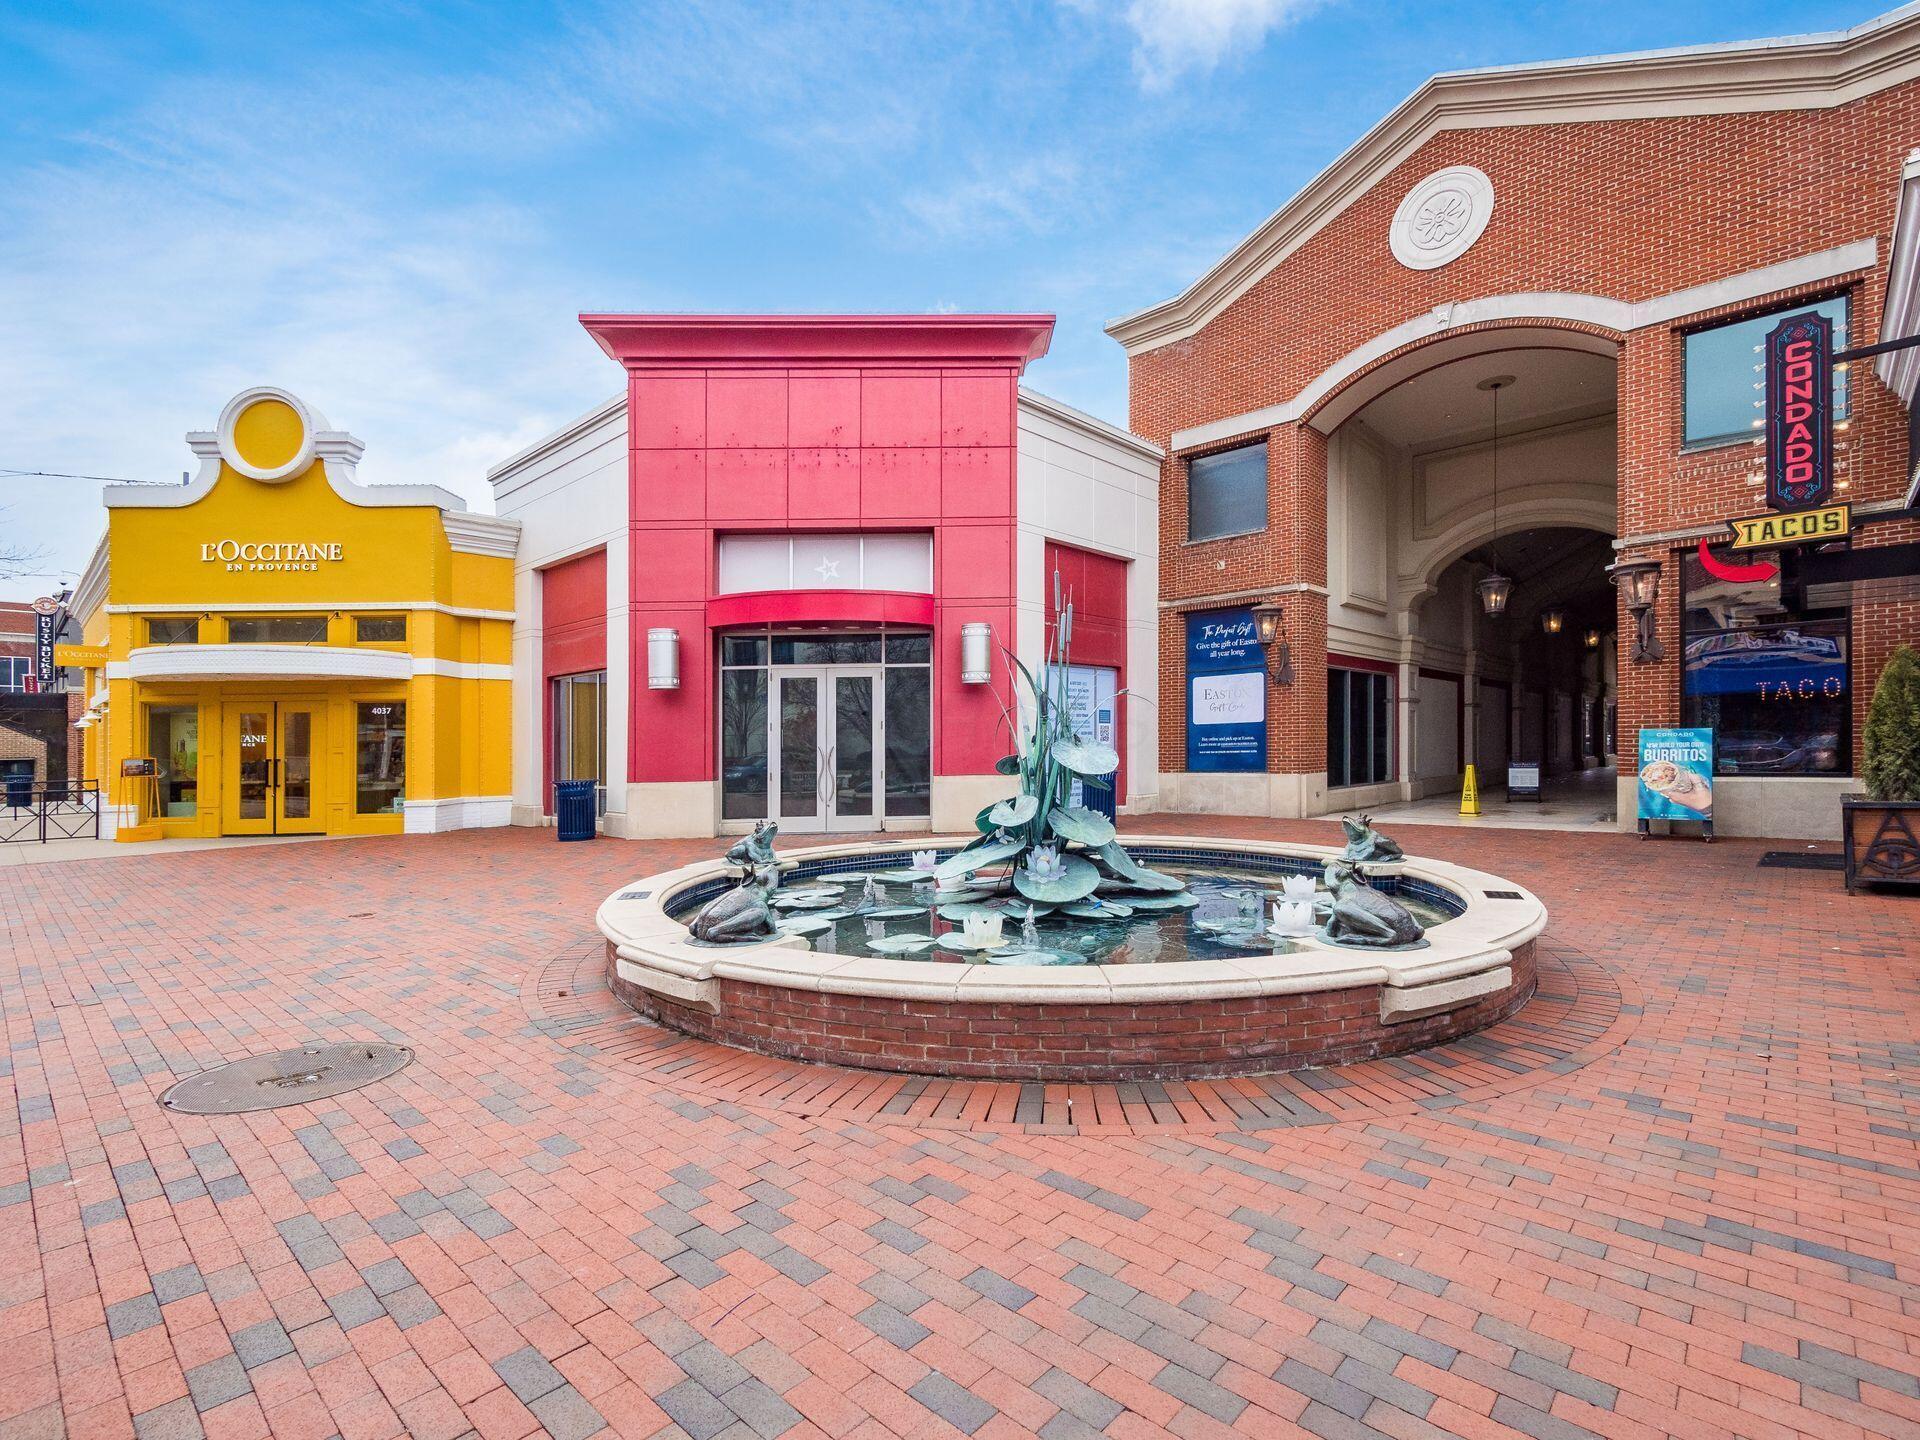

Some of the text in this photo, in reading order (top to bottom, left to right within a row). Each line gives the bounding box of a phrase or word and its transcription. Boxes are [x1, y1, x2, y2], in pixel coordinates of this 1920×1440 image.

[1785, 341, 1813, 483] CONDADO
[1742, 511, 1841, 543] TACOS
[200, 539, 343, 562] L'OCCITANE
[227, 563, 318, 571] EN PROVENCE
[41, 616, 52, 644] RUSTY
[1202, 622, 1253, 639] The Perfect Gift
[1196, 642, 1210, 650] Give
[1220, 640, 1231, 649] gift
[1231, 639, 1239, 647] of
[1217, 650, 1230, 659] year
[41, 645, 52, 679] BUCKET
[1755, 676, 1841, 701] TACO
[371, 707, 392, 715] 4037
[1644, 749, 1706, 761] BURRITOS
